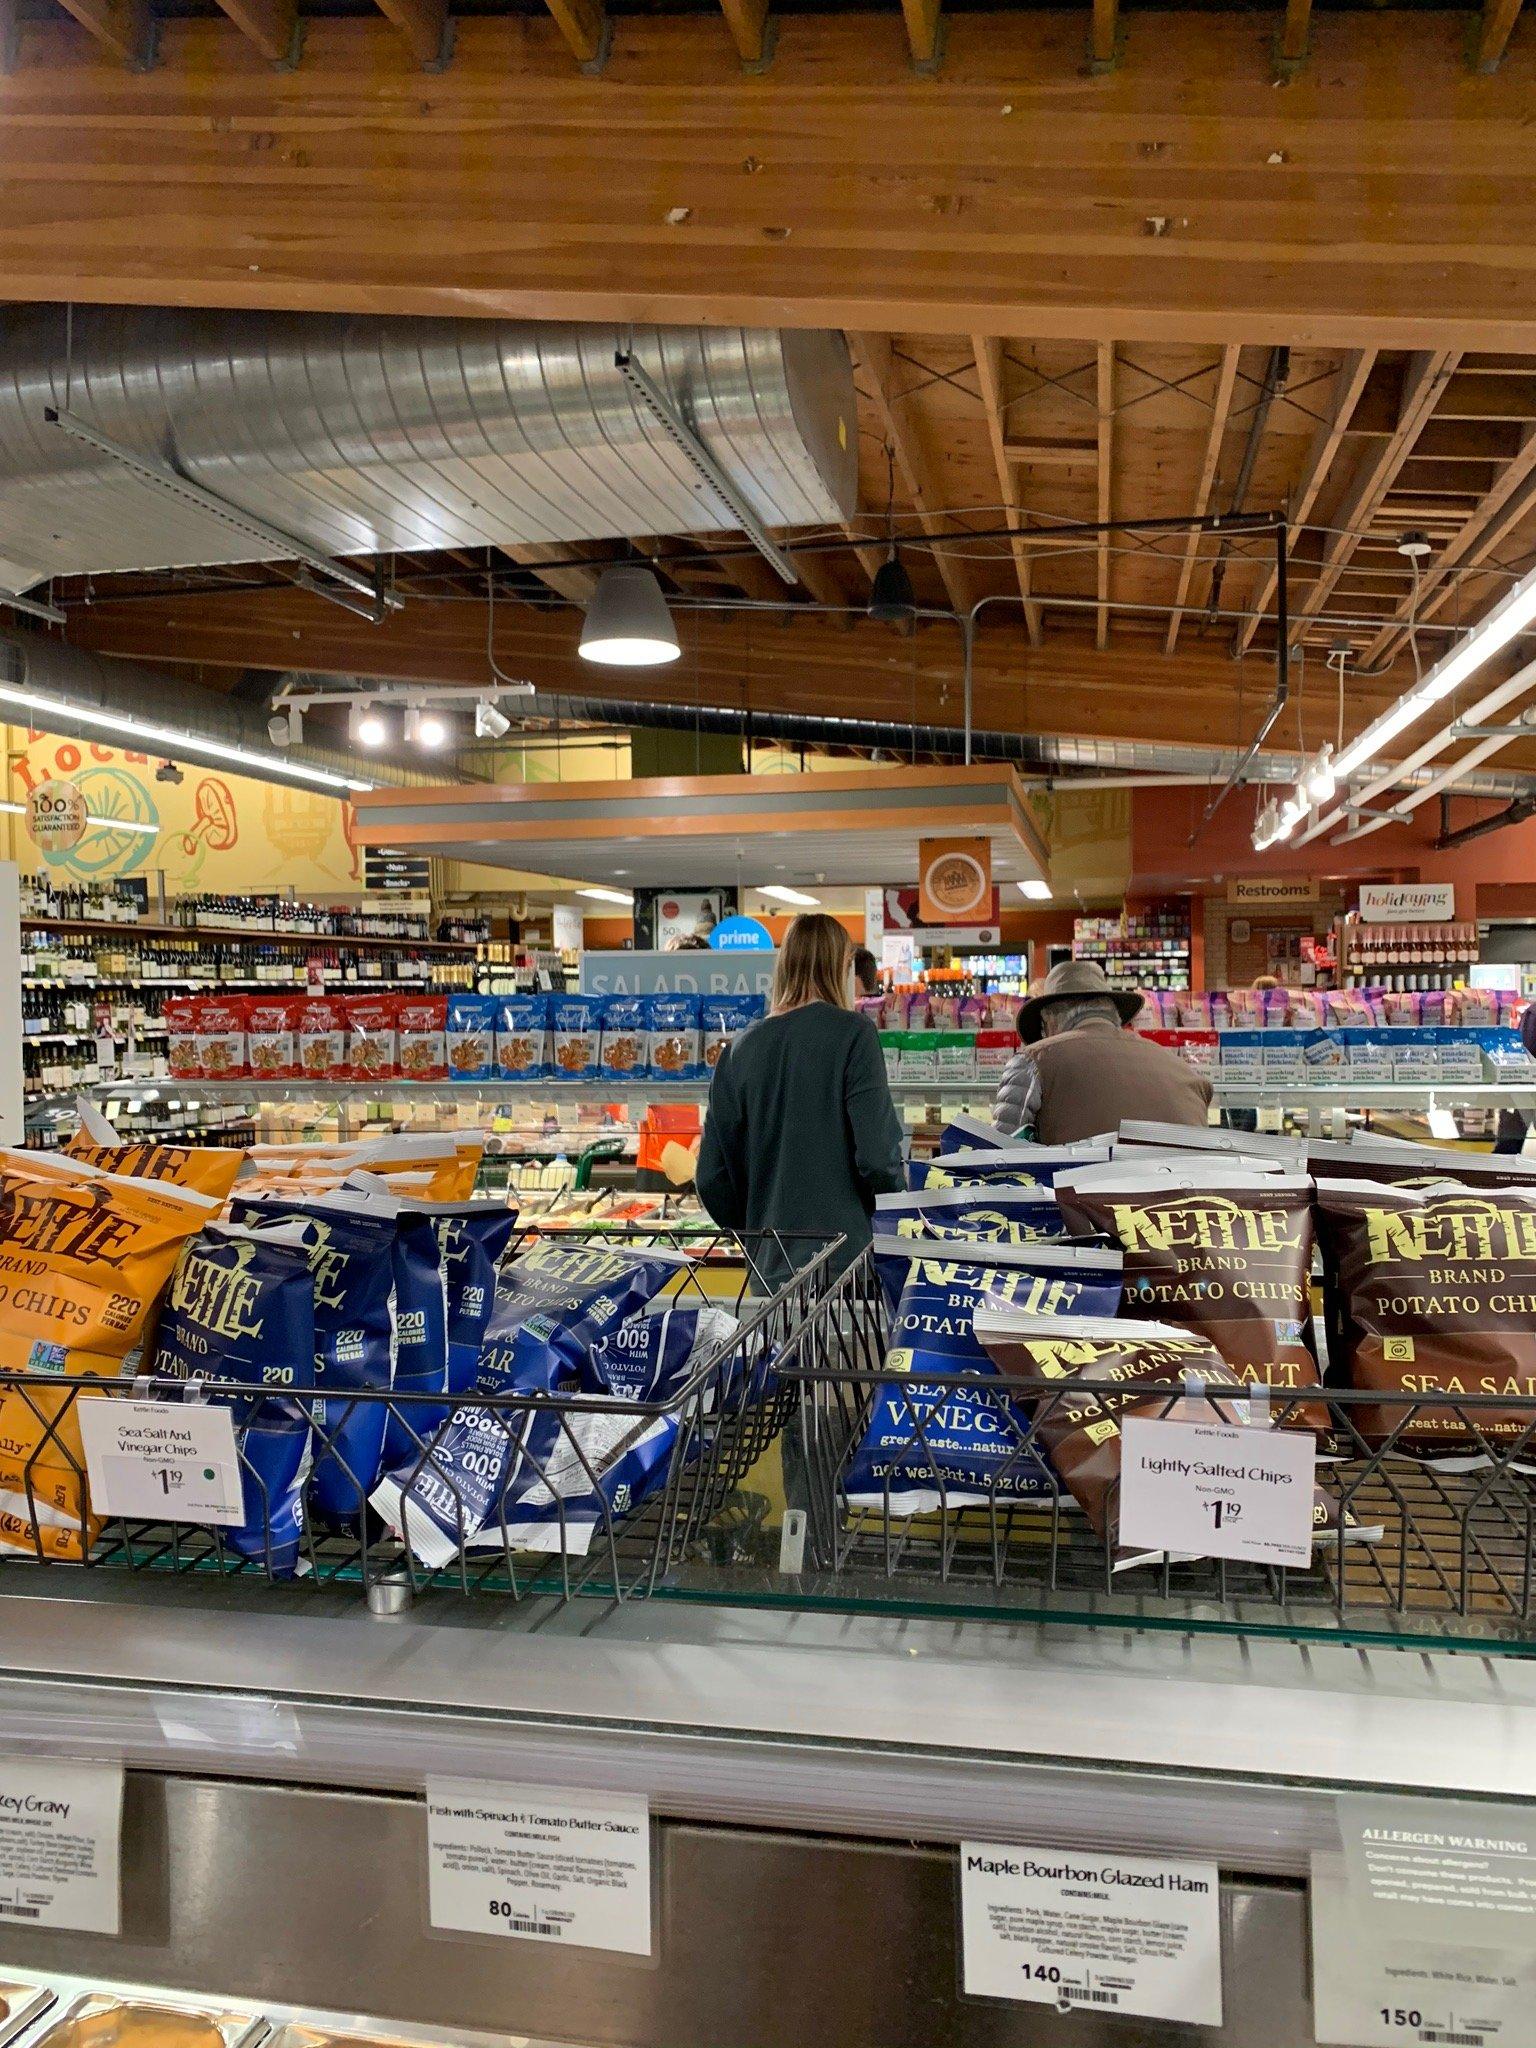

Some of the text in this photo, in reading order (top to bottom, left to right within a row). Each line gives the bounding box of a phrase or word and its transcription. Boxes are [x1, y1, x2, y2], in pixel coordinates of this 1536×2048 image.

[33, 799, 79, 814] 100%
[33, 815, 80, 823] SATISFACTION
[33, 823, 80, 833] GUARANTEED
[1237, 885, 1310, 897] Restrooms
[1366, 892, 1448, 906] holidaying
[719, 930, 759, 946] prime
[592, 973, 773, 996] SALAD BAR
[62, 1145, 192, 1188] ETTLE
[1105, 1196, 1302, 1253] KETTLE
[1177, 1257, 1247, 1273] BRAND
[1429, 1269, 1505, 1284] BRAND
[462, 1286, 484, 1302] 220
[523, 1278, 568, 1294] BRAND
[1126, 1281, 1303, 1304] POTATO CHIPS
[108, 1294, 141, 1316] 220
[495, 1287, 535, 1306] TATO
[12, 1288, 91, 1325] CHIPS
[596, 1295, 618, 1316] 220
[1376, 1295, 1536, 1316] POTATO CHI
[397, 1311, 425, 1328] 220
[893, 1315, 972, 1336] POTAT
[176, 1325, 208, 1354] BRAND
[336, 1330, 365, 1346] 220
[398, 1328, 425, 1336] CALORIES
[617, 1329, 649, 1349] 600
[336, 1343, 363, 1353] CALORIES
[629, 1351, 648, 1359] WITH
[154, 1349, 189, 1380] TATO
[611, 1363, 646, 1373] POTATO
[1109, 1353, 1182, 1382] BRAND
[262, 1367, 294, 1383] 220
[1228, 1363, 1301, 1388] ALT
[1480, 1376, 1536, 1396] SAL
[1405, 1419, 1438, 1429] reat
[118, 1426, 192, 1441] Sea Salt And
[1195, 1428, 1239, 1439] Kettle Foods
[118, 1440, 198, 1456] Vinegar Chips
[143, 1456, 175, 1464] Non-GMO
[462, 1452, 501, 1481] 600
[1141, 1457, 1293, 1484] Lightly Salted Chips
[476, 1476, 495, 1491] WITH
[970, 1473, 992, 1488] 1.5
[455, 1476, 490, 1505] POTATO
[1195, 1485, 1235, 1496] Non-GMO
[25, 1795, 70, 1819] Gravy
[429, 1805, 451, 1817] Fish
[453, 1809, 474, 1819] with
[475, 1809, 518, 1823] Spinach
[528, 1814, 567, 1827] Tomato
[569, 1818, 601, 1831] Butter
[604, 1821, 639, 1834] Sauce
[1363, 1829, 1528, 1853] ALLERGEN WARNING
[967, 1857, 1209, 1894] Maple Bourbon Glazed Ham
[489, 1901, 511, 1917] 80
[1022, 1964, 1060, 1983] 140
[1380, 2008, 1422, 2027] 150
